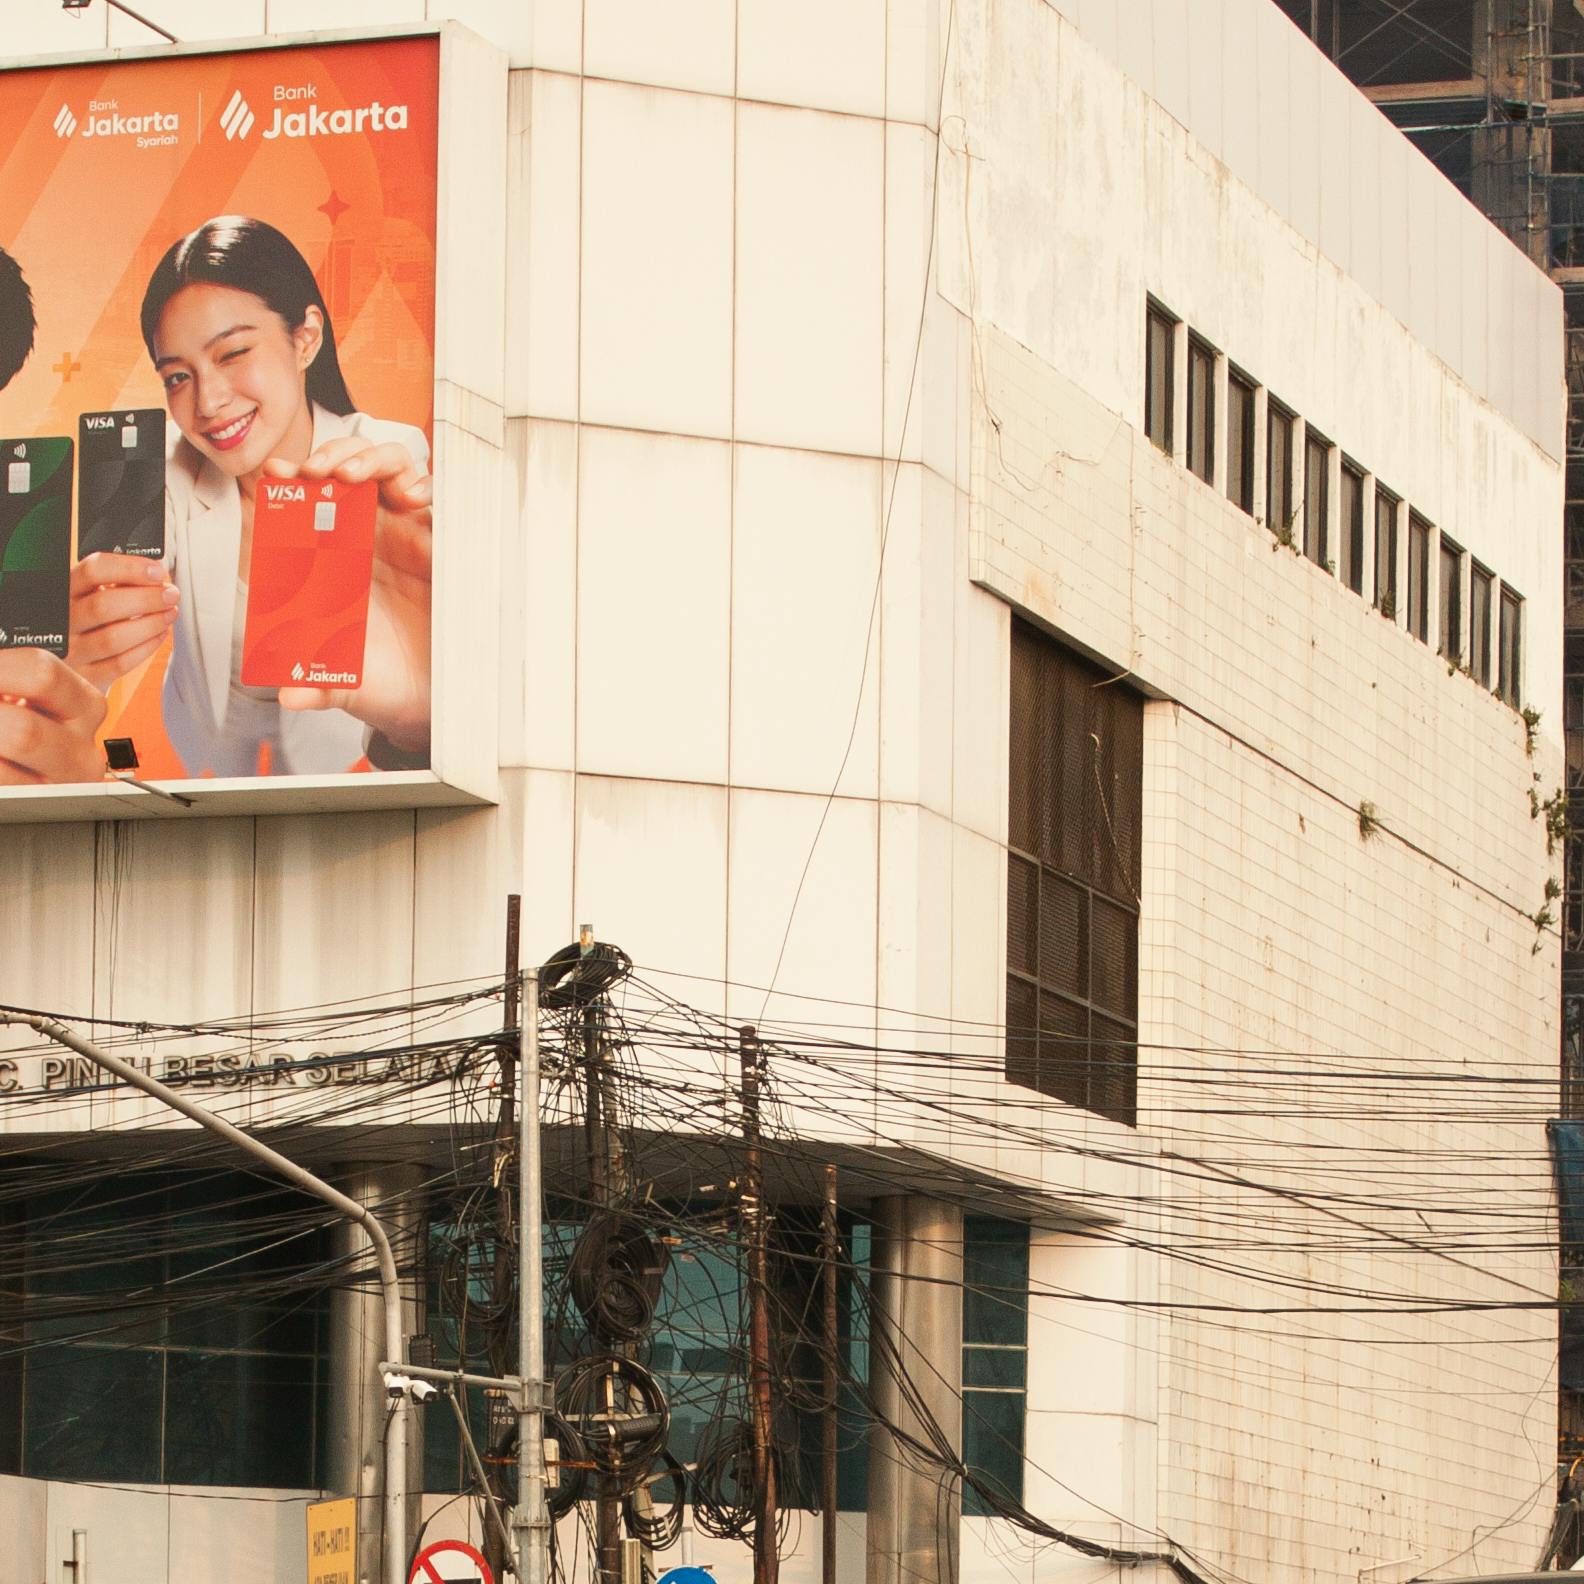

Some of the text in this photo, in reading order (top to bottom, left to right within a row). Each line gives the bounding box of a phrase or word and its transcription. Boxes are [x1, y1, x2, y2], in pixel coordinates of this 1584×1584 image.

[273, 84, 318, 102] Bank
[89, 98, 119, 112] Bank
[81, 111, 179, 138] Jakarta
[262, 102, 408, 139] Jakarta
[136, 134, 179, 150] Syariah
[84, 416, 115, 430] VISA
[263, 485, 306, 502] VISA
[10, 632, 64, 645] Jakarta
[305, 670, 357, 684] Jakarta
[164, 1055, 297, 1088] BESAR
